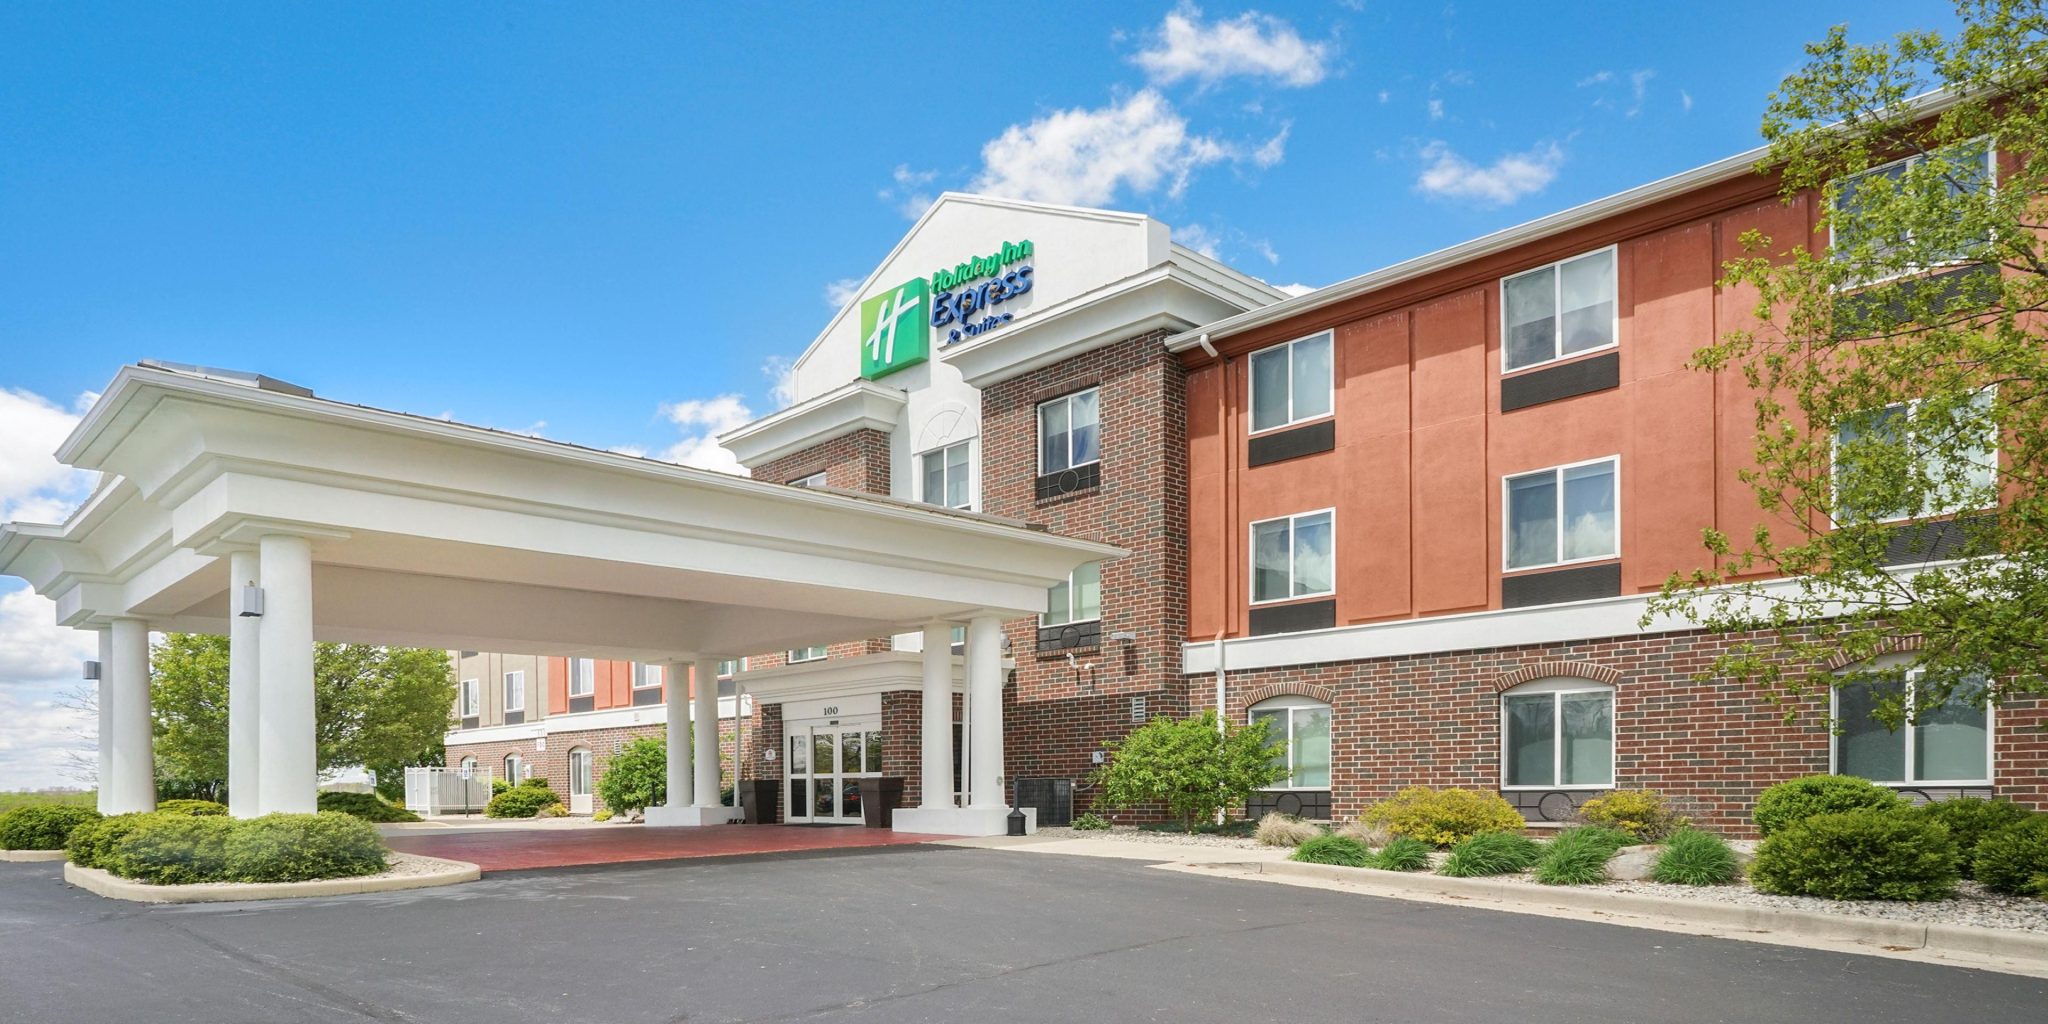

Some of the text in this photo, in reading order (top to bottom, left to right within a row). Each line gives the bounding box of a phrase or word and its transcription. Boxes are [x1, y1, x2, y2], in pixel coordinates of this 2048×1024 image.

[930, 265, 1034, 328] Express
[931, 239, 1034, 295] Holiday Inn
[865, 287, 920, 364] H
[823, 706, 839, 716] 100
